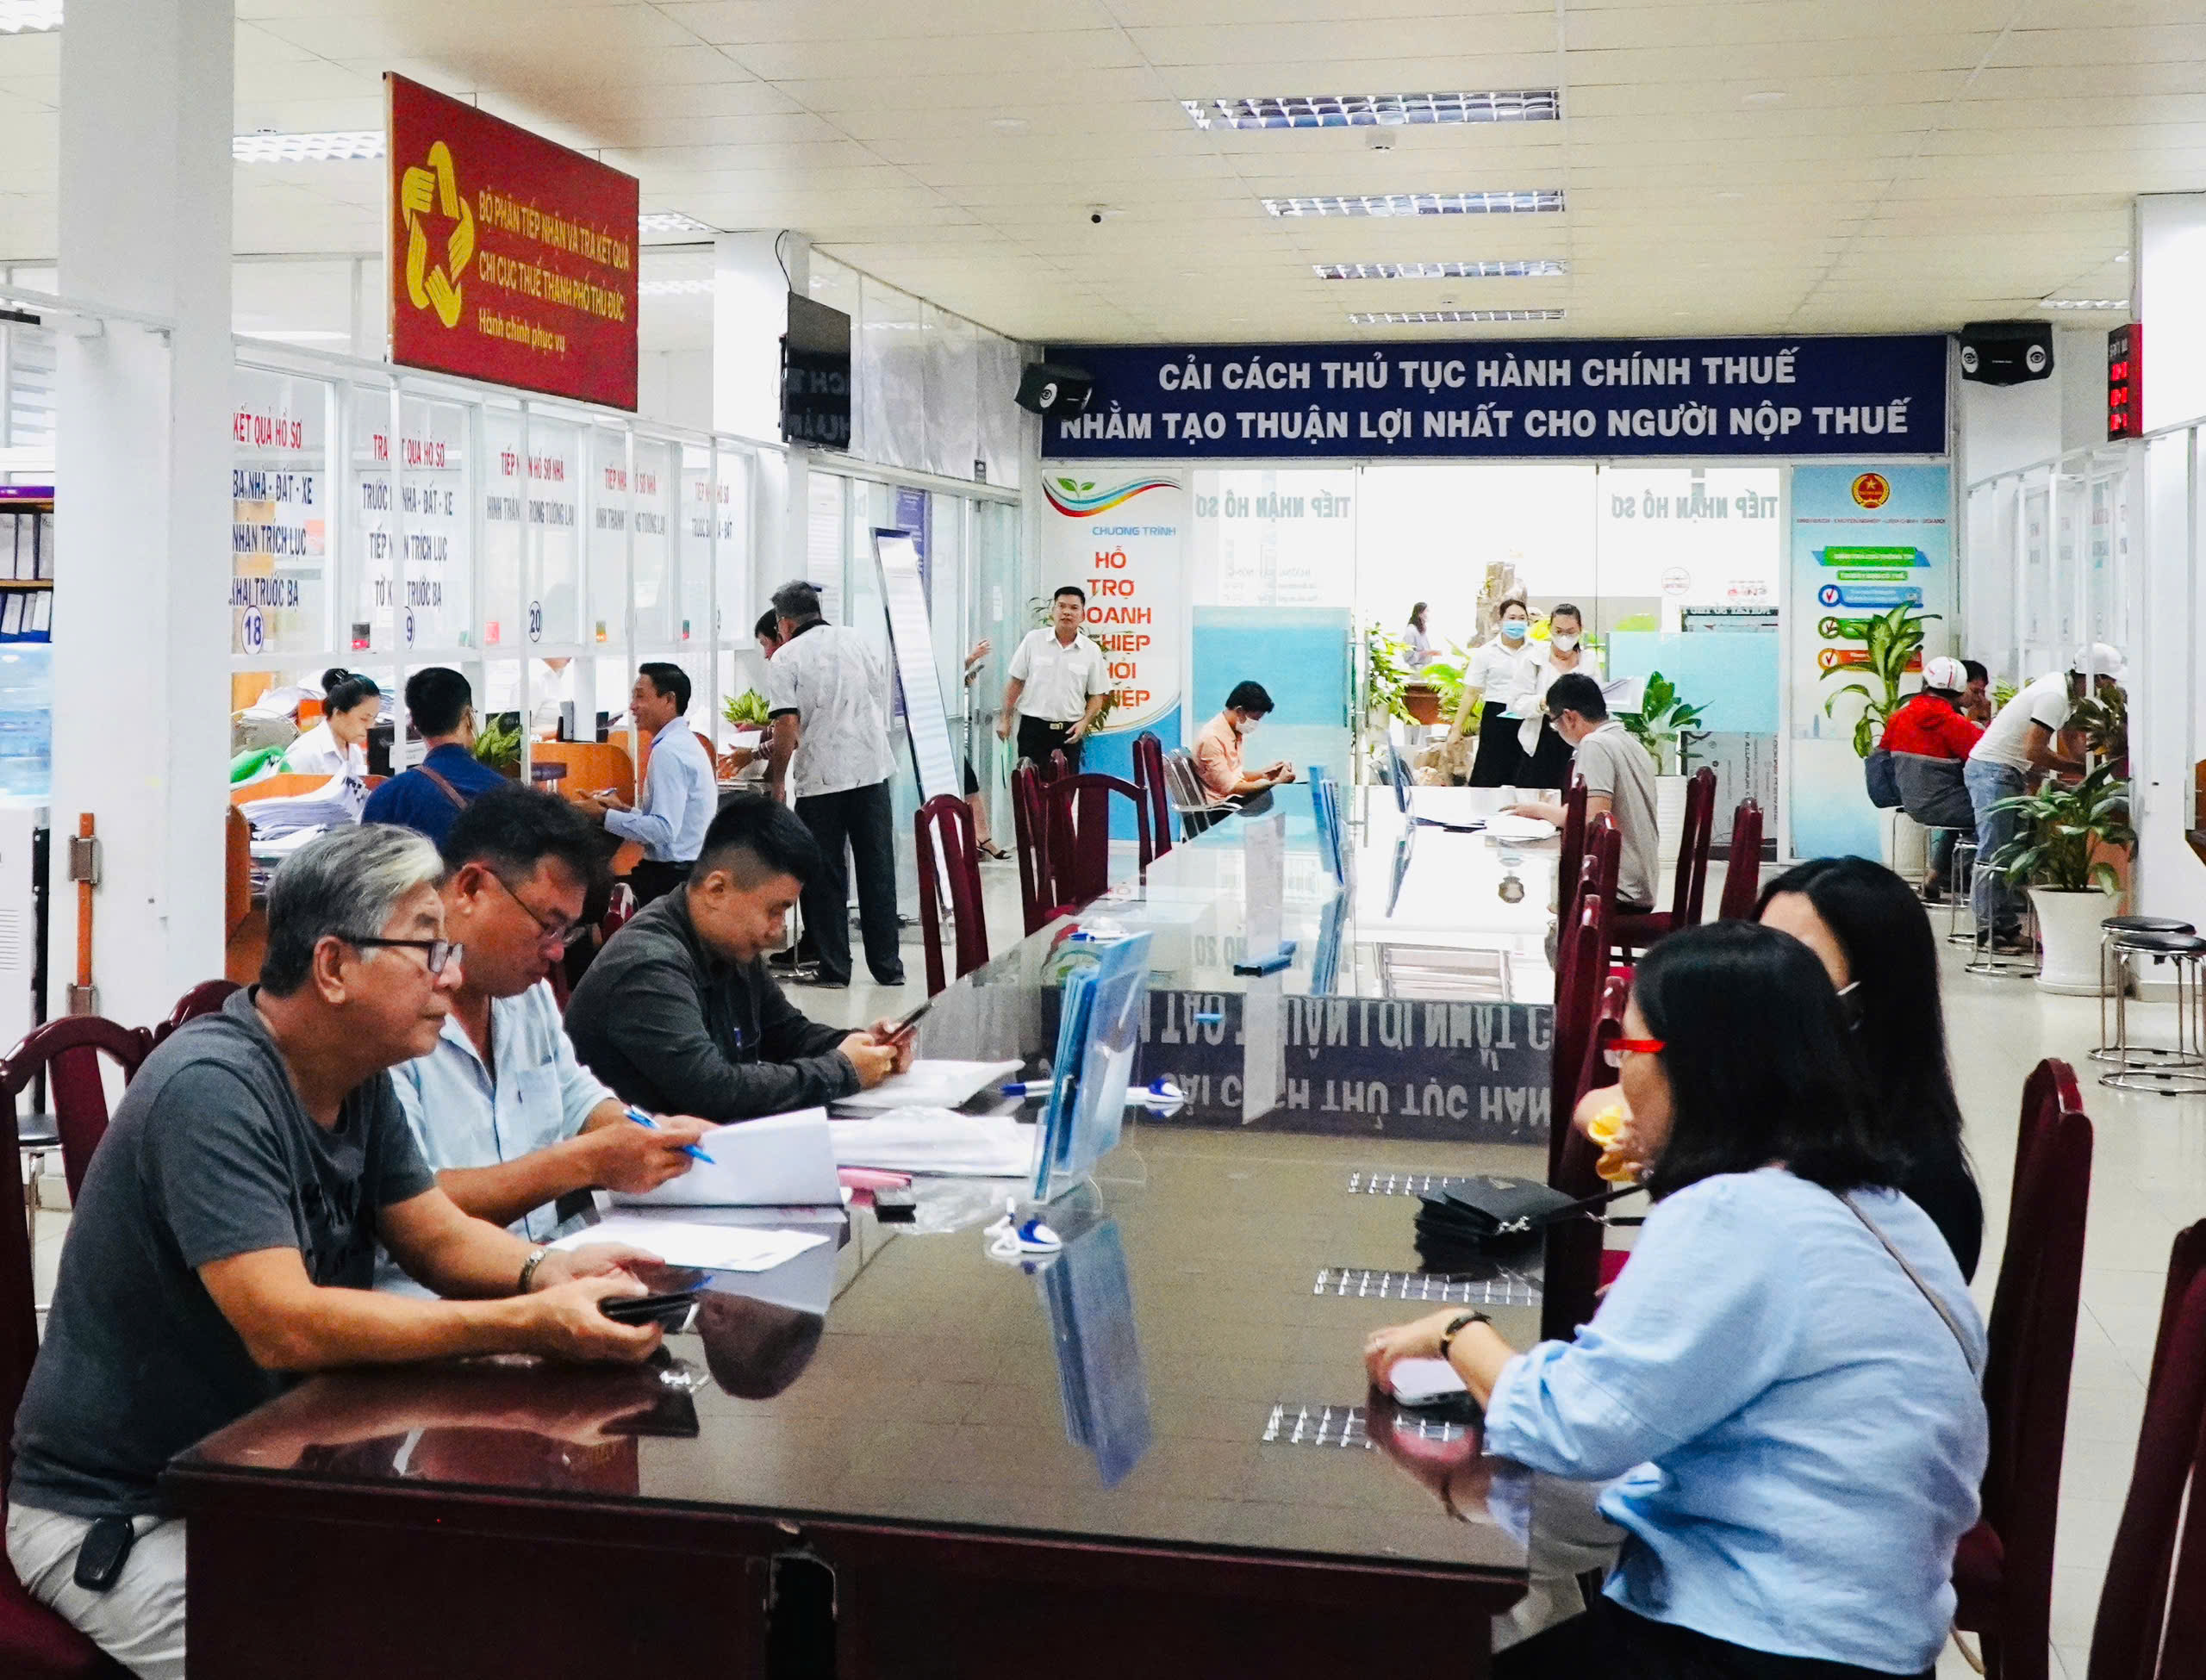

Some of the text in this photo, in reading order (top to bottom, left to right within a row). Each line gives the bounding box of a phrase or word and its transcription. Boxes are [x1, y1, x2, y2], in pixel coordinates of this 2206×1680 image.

[521, 196, 541, 240] TIẾP
[479, 249, 496, 283] CHI
[497, 256, 517, 297] CỤC
[519, 256, 542, 297] THUẾ
[573, 271, 590, 311] PHỐ
[1159, 346, 1800, 395] CẢI CÁCH THỦ TỤC HÀNH CHÍNH THUẾ
[254, 406, 272, 448] QUẢ
[275, 408, 288, 446] HỒ
[290, 419, 302, 449] SƠ
[1061, 397, 1911, 445] NHẰM TẠO THUẬN LỢI NHẤT CHO NGƯỜI NỘP THUẾ
[302, 476, 313, 505] XE
[444, 489, 453, 516] XE
[260, 518, 288, 555] TRÍCH
[290, 527, 307, 562] LỤC
[1094, 545, 1127, 569] HỖ
[1087, 578, 1136, 600] TRỢ
[245, 615, 262, 646] 18
[529, 609, 541, 633] 20
[1081, 606, 1152, 625] OANH
